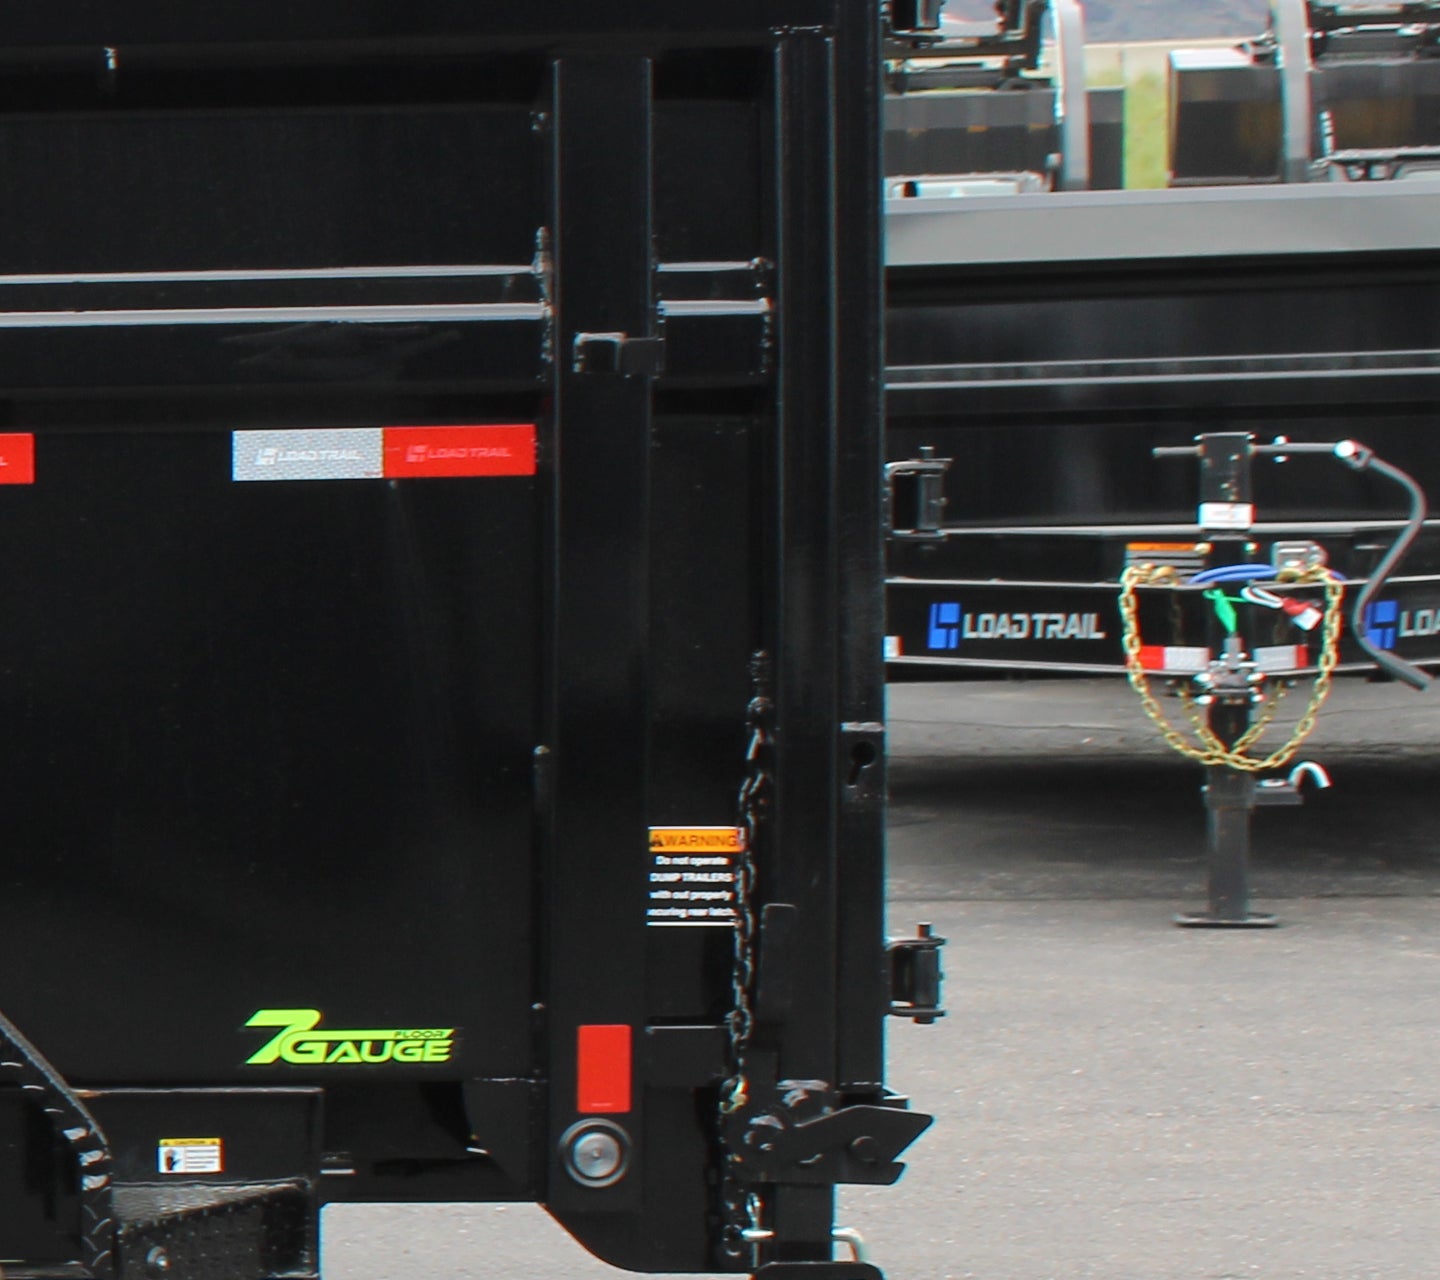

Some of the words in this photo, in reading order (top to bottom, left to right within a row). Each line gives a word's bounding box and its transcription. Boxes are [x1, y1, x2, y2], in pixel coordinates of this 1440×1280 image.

[428, 449, 469, 459] LOAD
[469, 447, 511, 457] TRAIL
[962, 613, 1030, 639] LOAD
[1031, 613, 1107, 640] TRAIL
[664, 835, 738, 847] WARNING
